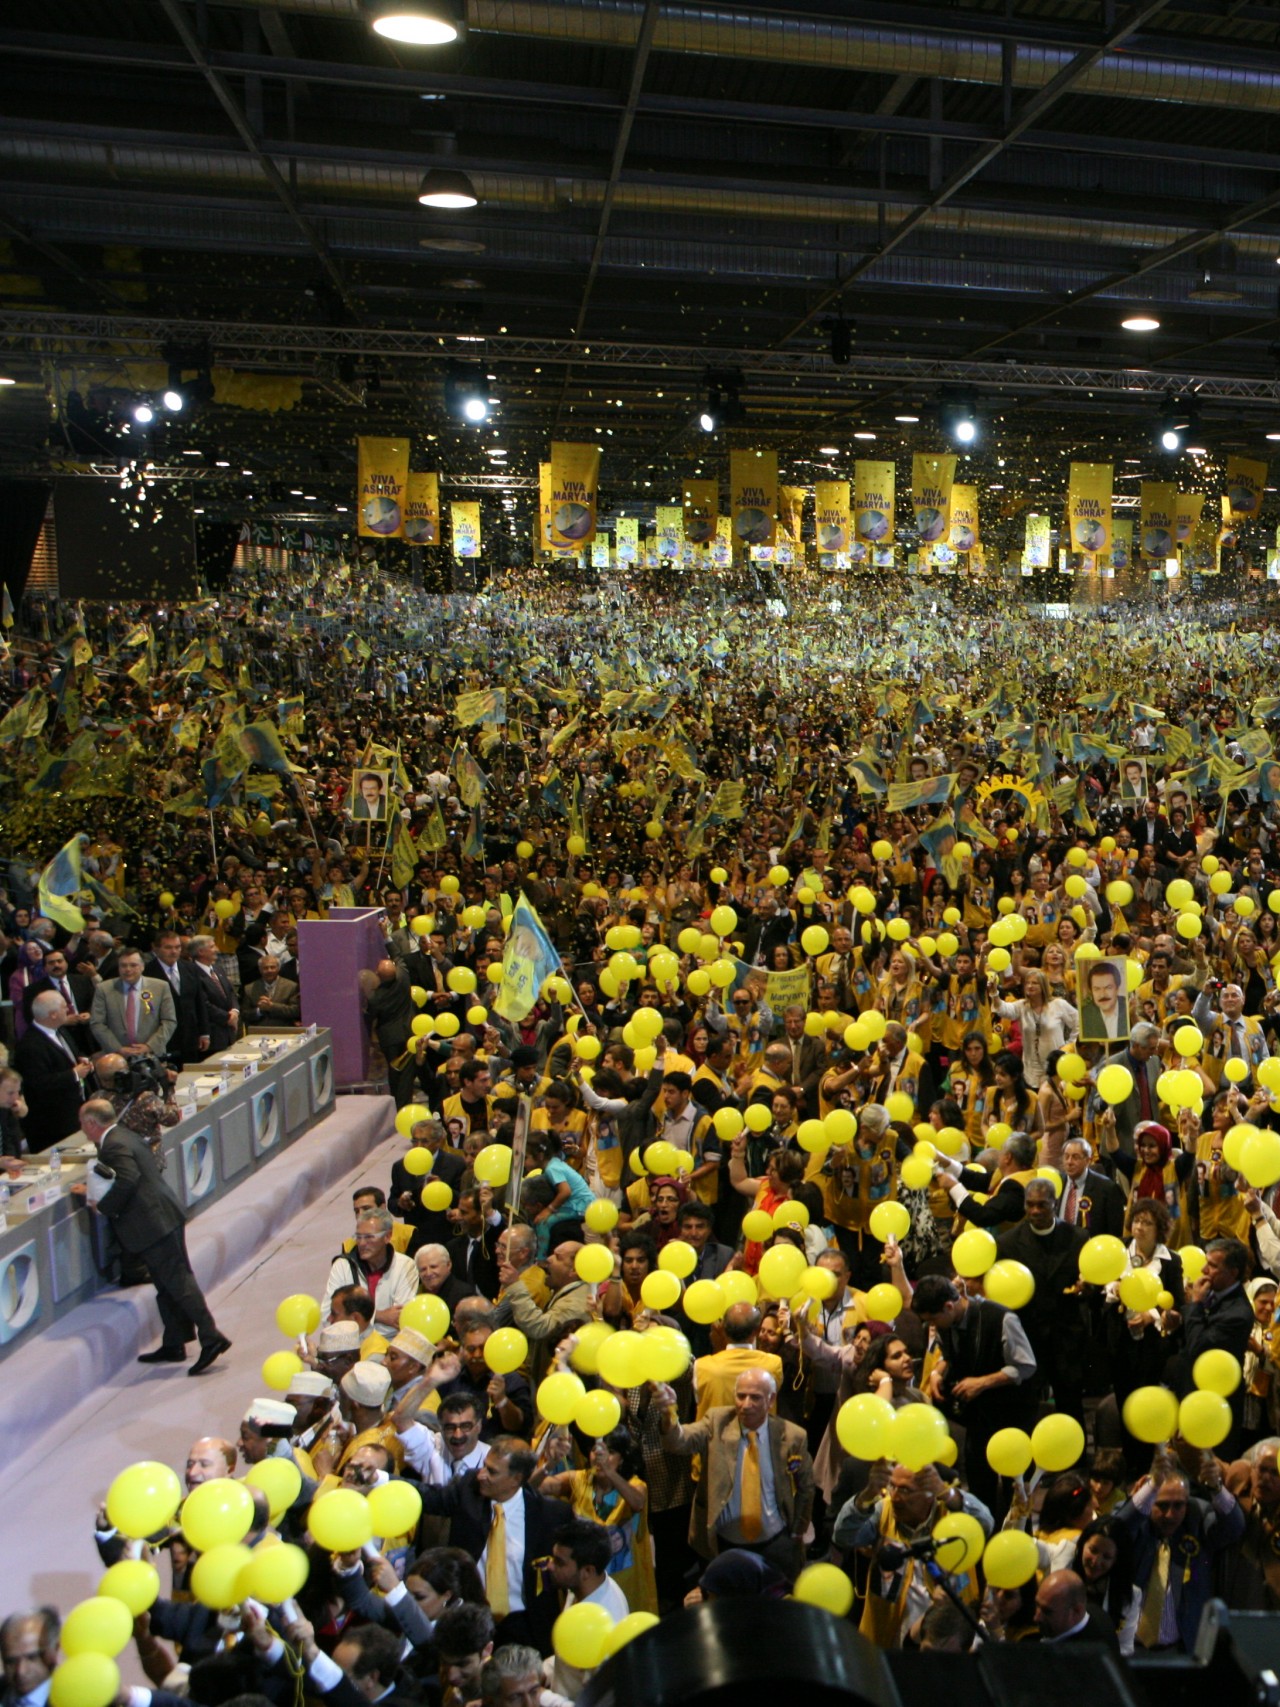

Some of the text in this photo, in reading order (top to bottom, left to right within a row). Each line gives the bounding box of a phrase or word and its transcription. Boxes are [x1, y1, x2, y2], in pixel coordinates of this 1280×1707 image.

[370, 474, 396, 485] VIVA
[363, 484, 403, 496] ASHRAF
[562, 481, 586, 492] VIVA
[553, 491, 594, 503] MARYAM
[742, 487, 765, 497] VIVA
[864, 492, 883, 501] VIVA
[922, 488, 942, 498] VIVA
[408, 501, 428, 510] VIVA
[856, 501, 891, 510] MARYAM
[1079, 499, 1100, 508] VIVA
[1073, 507, 1106, 518] ASHRAF
[1150, 512, 1168, 520] VIVA
[816, 516, 848, 524] MARYAM
[975, 773, 1046, 803] MARYAM
[770, 992, 807, 1002] Maryam
